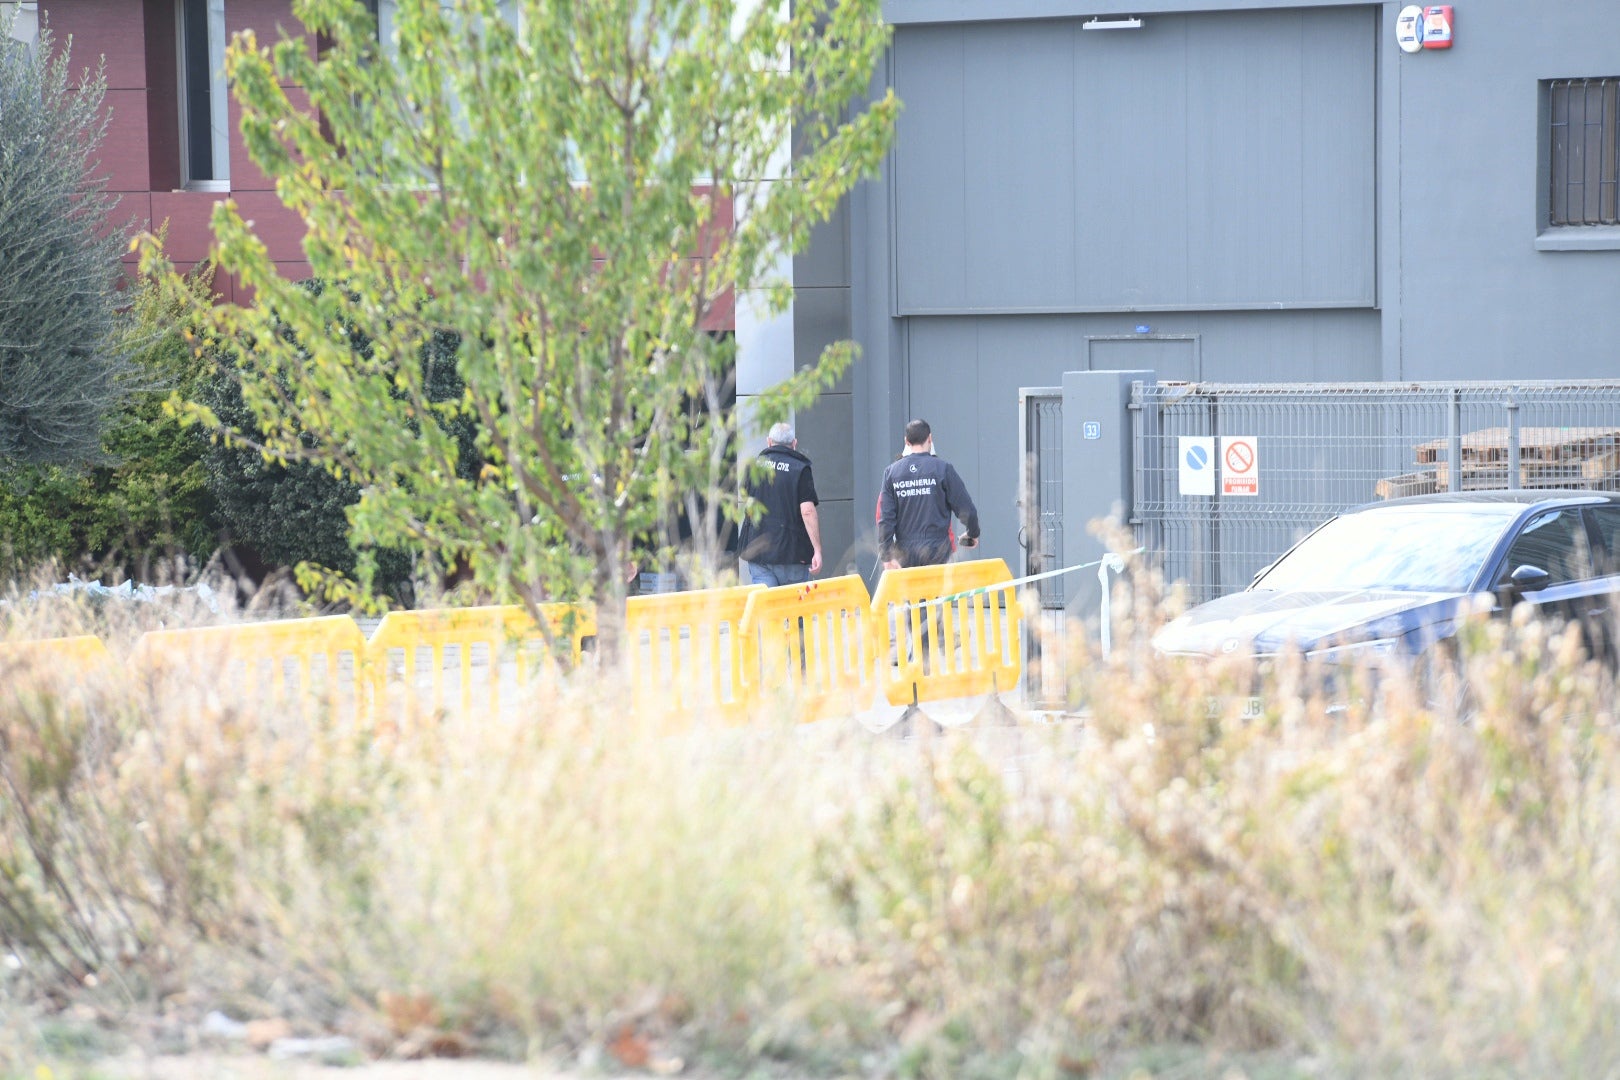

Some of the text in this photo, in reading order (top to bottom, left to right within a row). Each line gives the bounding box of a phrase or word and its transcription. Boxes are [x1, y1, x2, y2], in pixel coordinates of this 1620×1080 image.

[1086, 424, 1097, 437] 33
[892, 478, 937, 490] NGENIERIA
[896, 487, 931, 498] FORENSE
